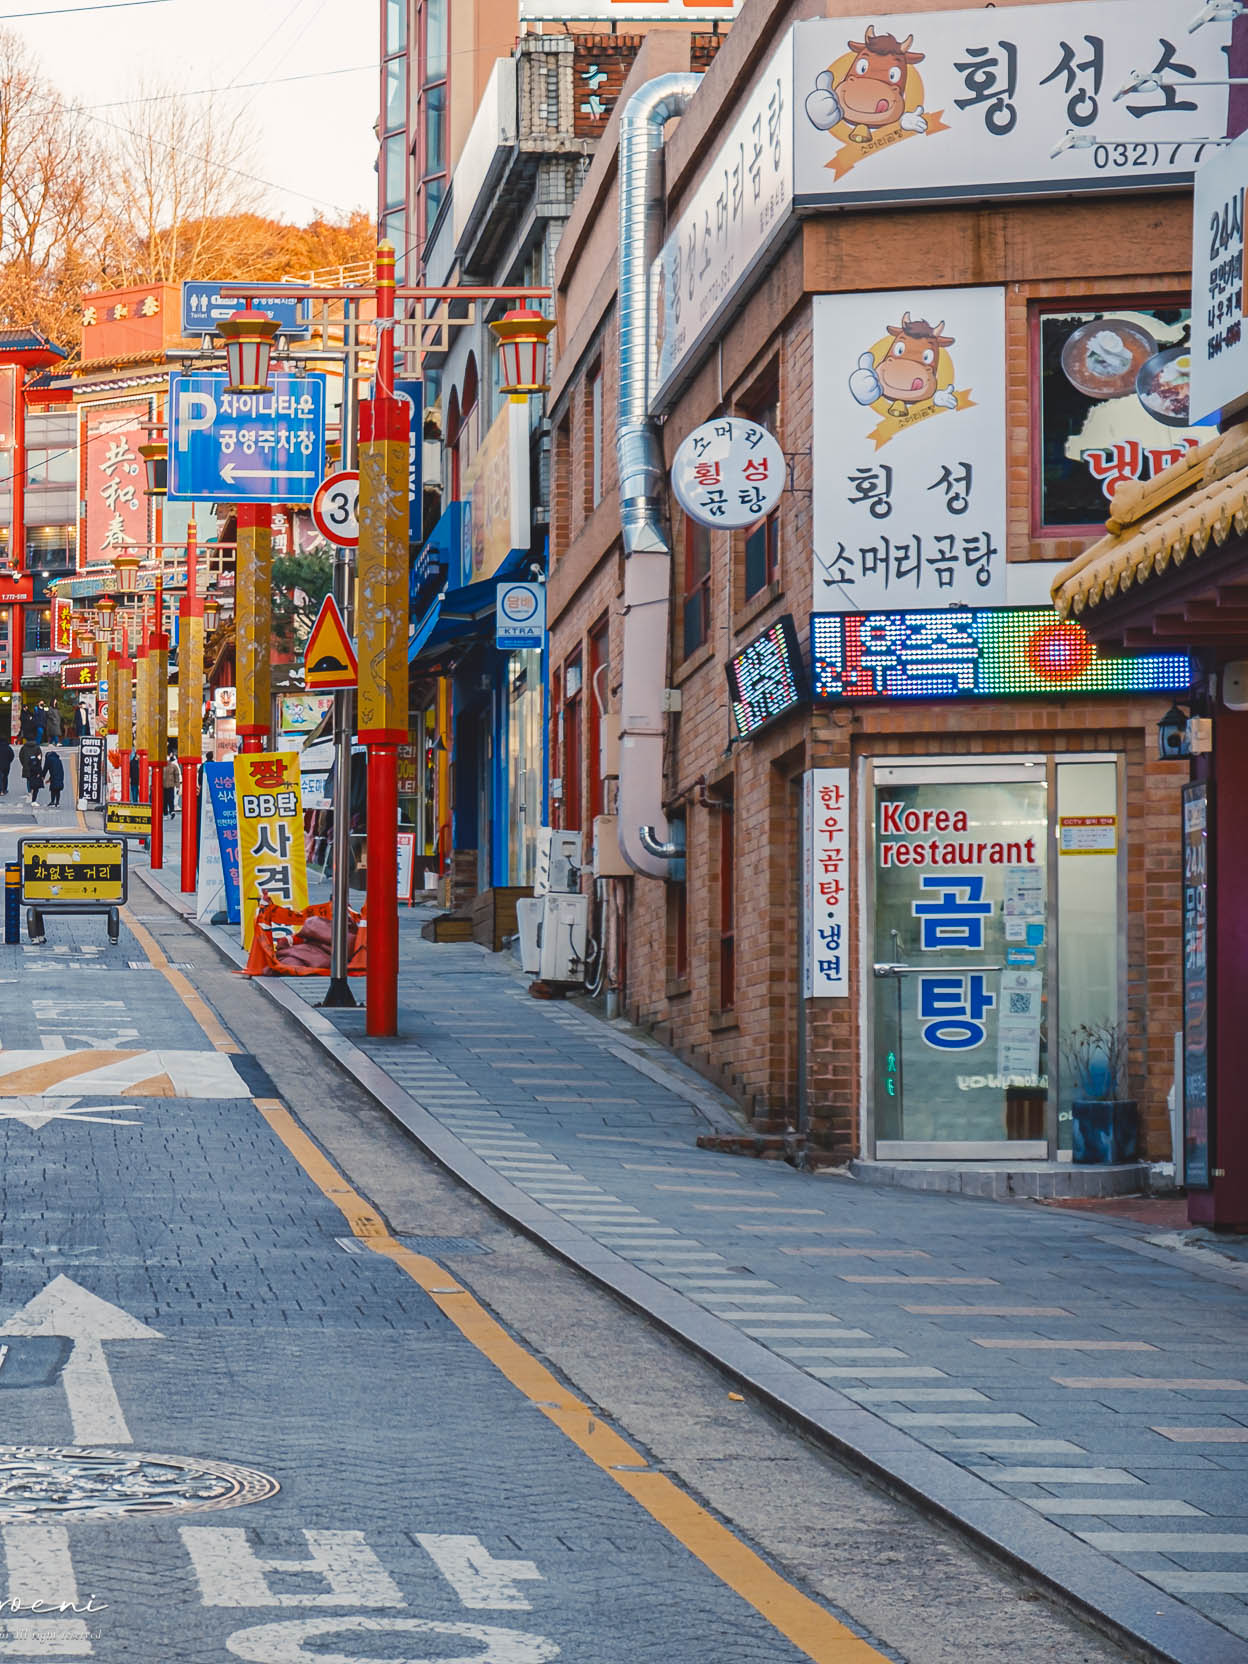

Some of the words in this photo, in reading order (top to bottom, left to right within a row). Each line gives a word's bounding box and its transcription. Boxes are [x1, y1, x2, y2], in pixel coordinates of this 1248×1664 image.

[1094, 143, 1212, 169] 032)77
[1209, 186, 1245, 261] 24시
[178, 391, 216, 452] P
[220, 395, 314, 418] 차이나타운
[219, 429, 316, 455] 공영주차장
[693, 422, 764, 457] 소머리
[693, 456, 770, 487] 횡성
[98, 436, 140, 553] 共和春
[700, 486, 767, 517] 곰탕
[847, 462, 974, 520] 횡성
[822, 531, 998, 590] 소머리곰탕
[214, 776, 235, 788] 신승
[250, 759, 289, 788] 짱
[242, 792, 297, 818] BB탄
[882, 802, 969, 834] Korea
[882, 835, 1038, 868] restaurant
[84, 865, 111, 879] 거리
[913, 875, 996, 1049] 곰탕
